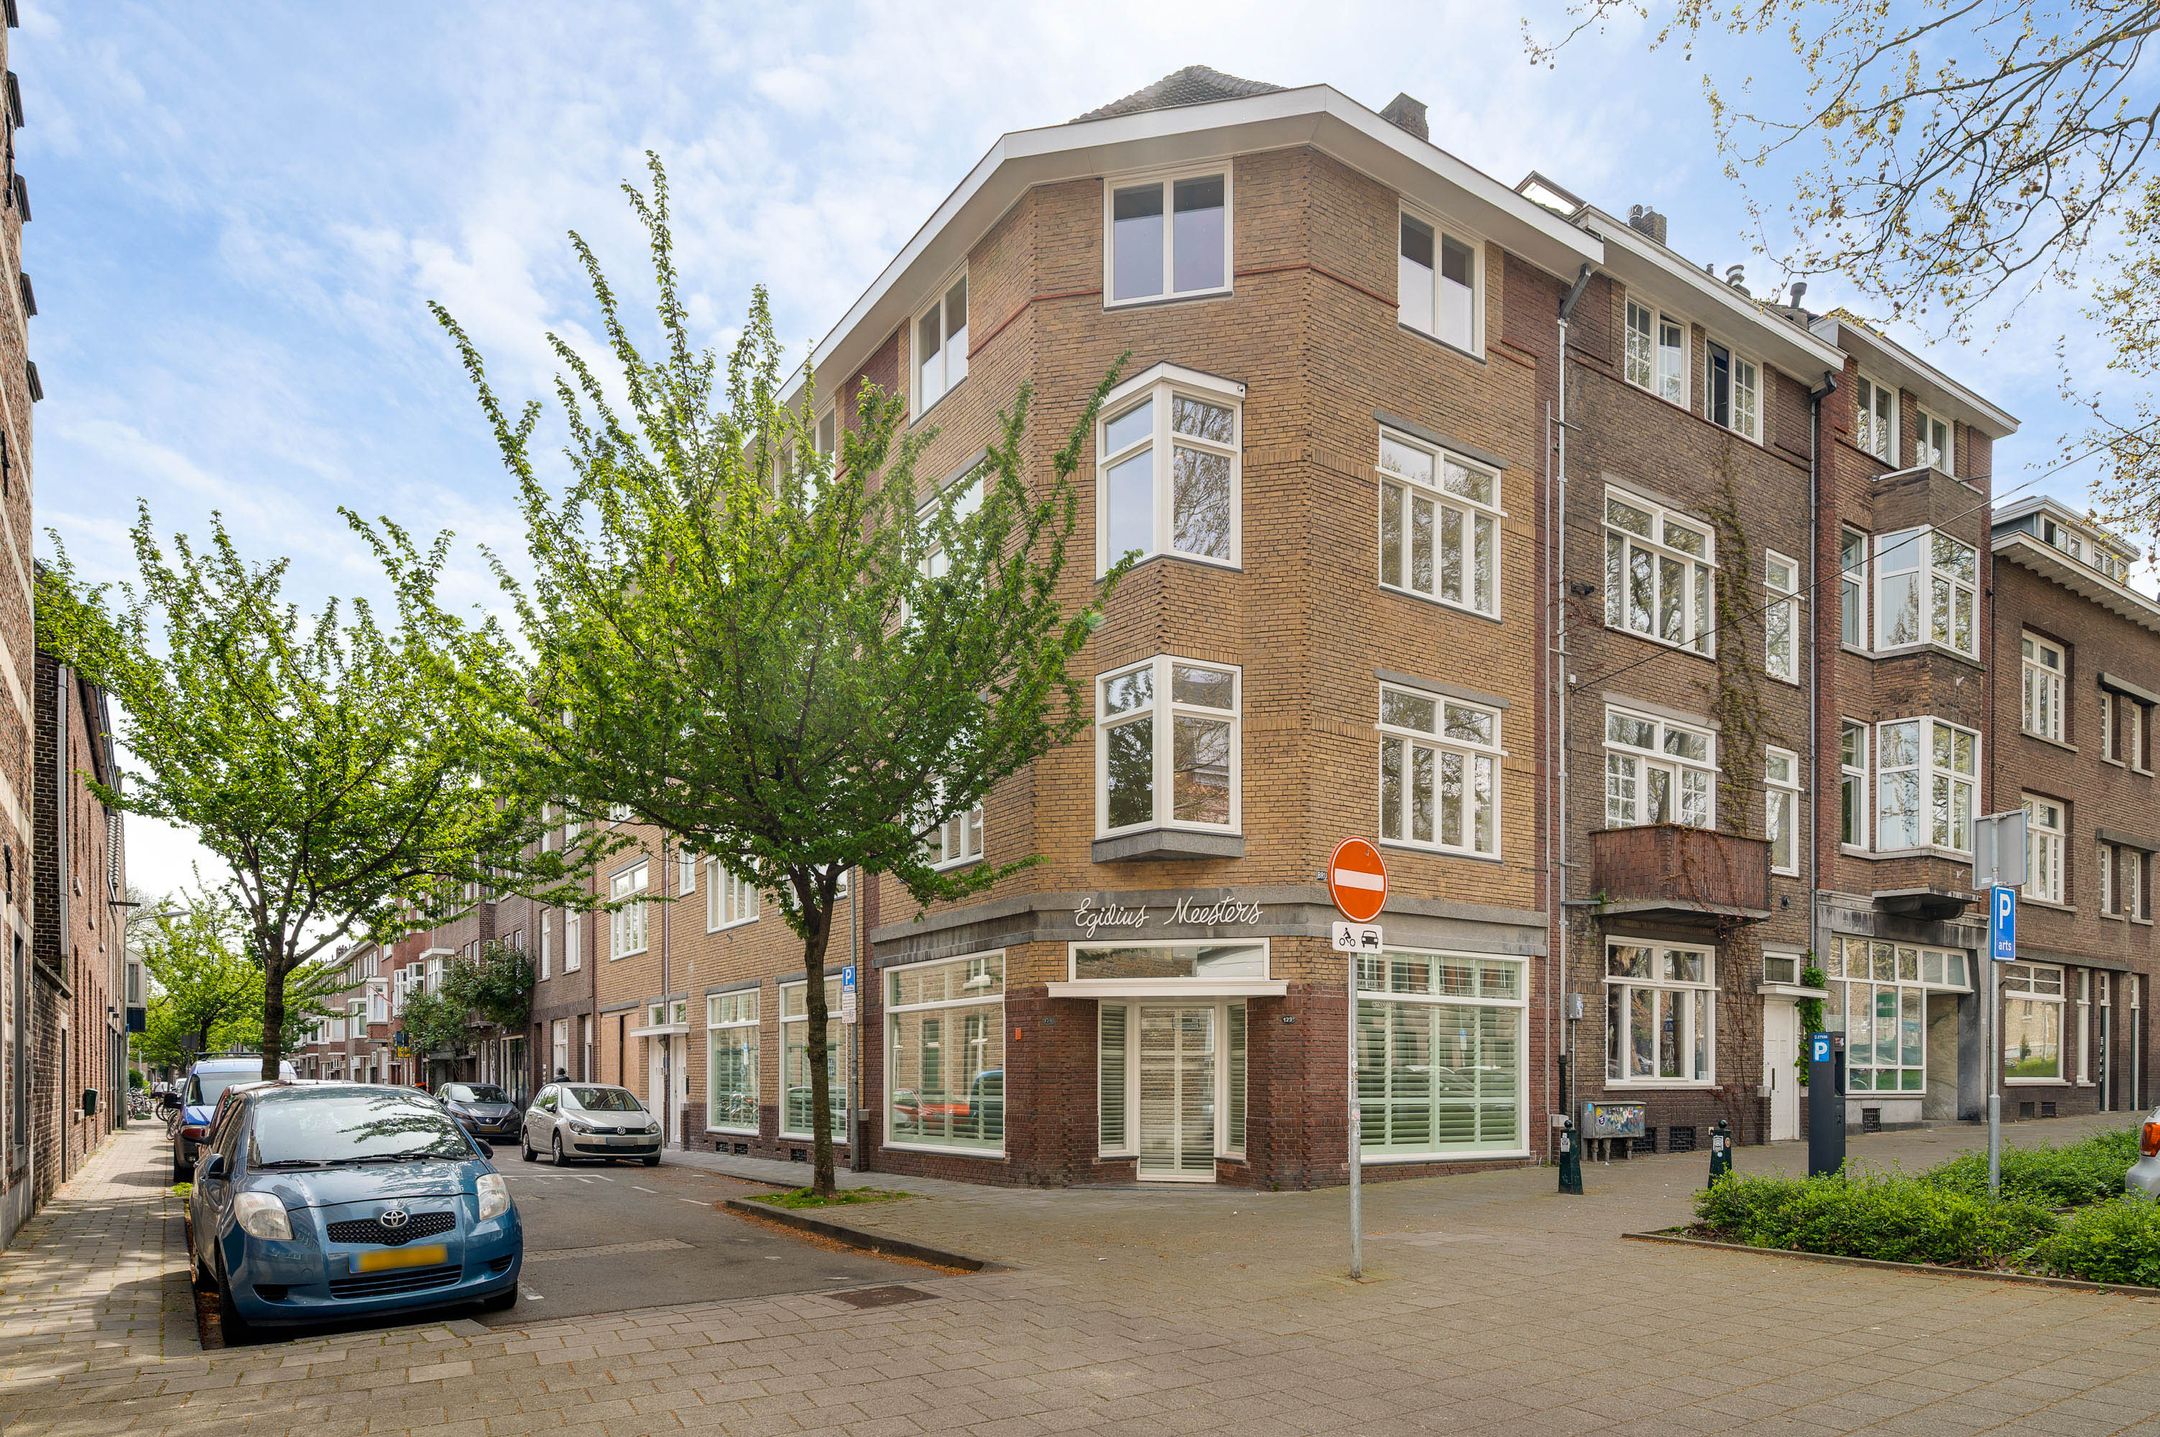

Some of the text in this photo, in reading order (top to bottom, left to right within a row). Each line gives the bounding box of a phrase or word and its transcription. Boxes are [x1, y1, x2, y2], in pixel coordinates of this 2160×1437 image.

[1074, 896, 1263, 938] Egidius Meesters
[1999, 893, 2011, 929] P
[1998, 941, 2012, 951] arts
[845, 969, 852, 986] P
[1814, 1041, 1828, 1061] P
